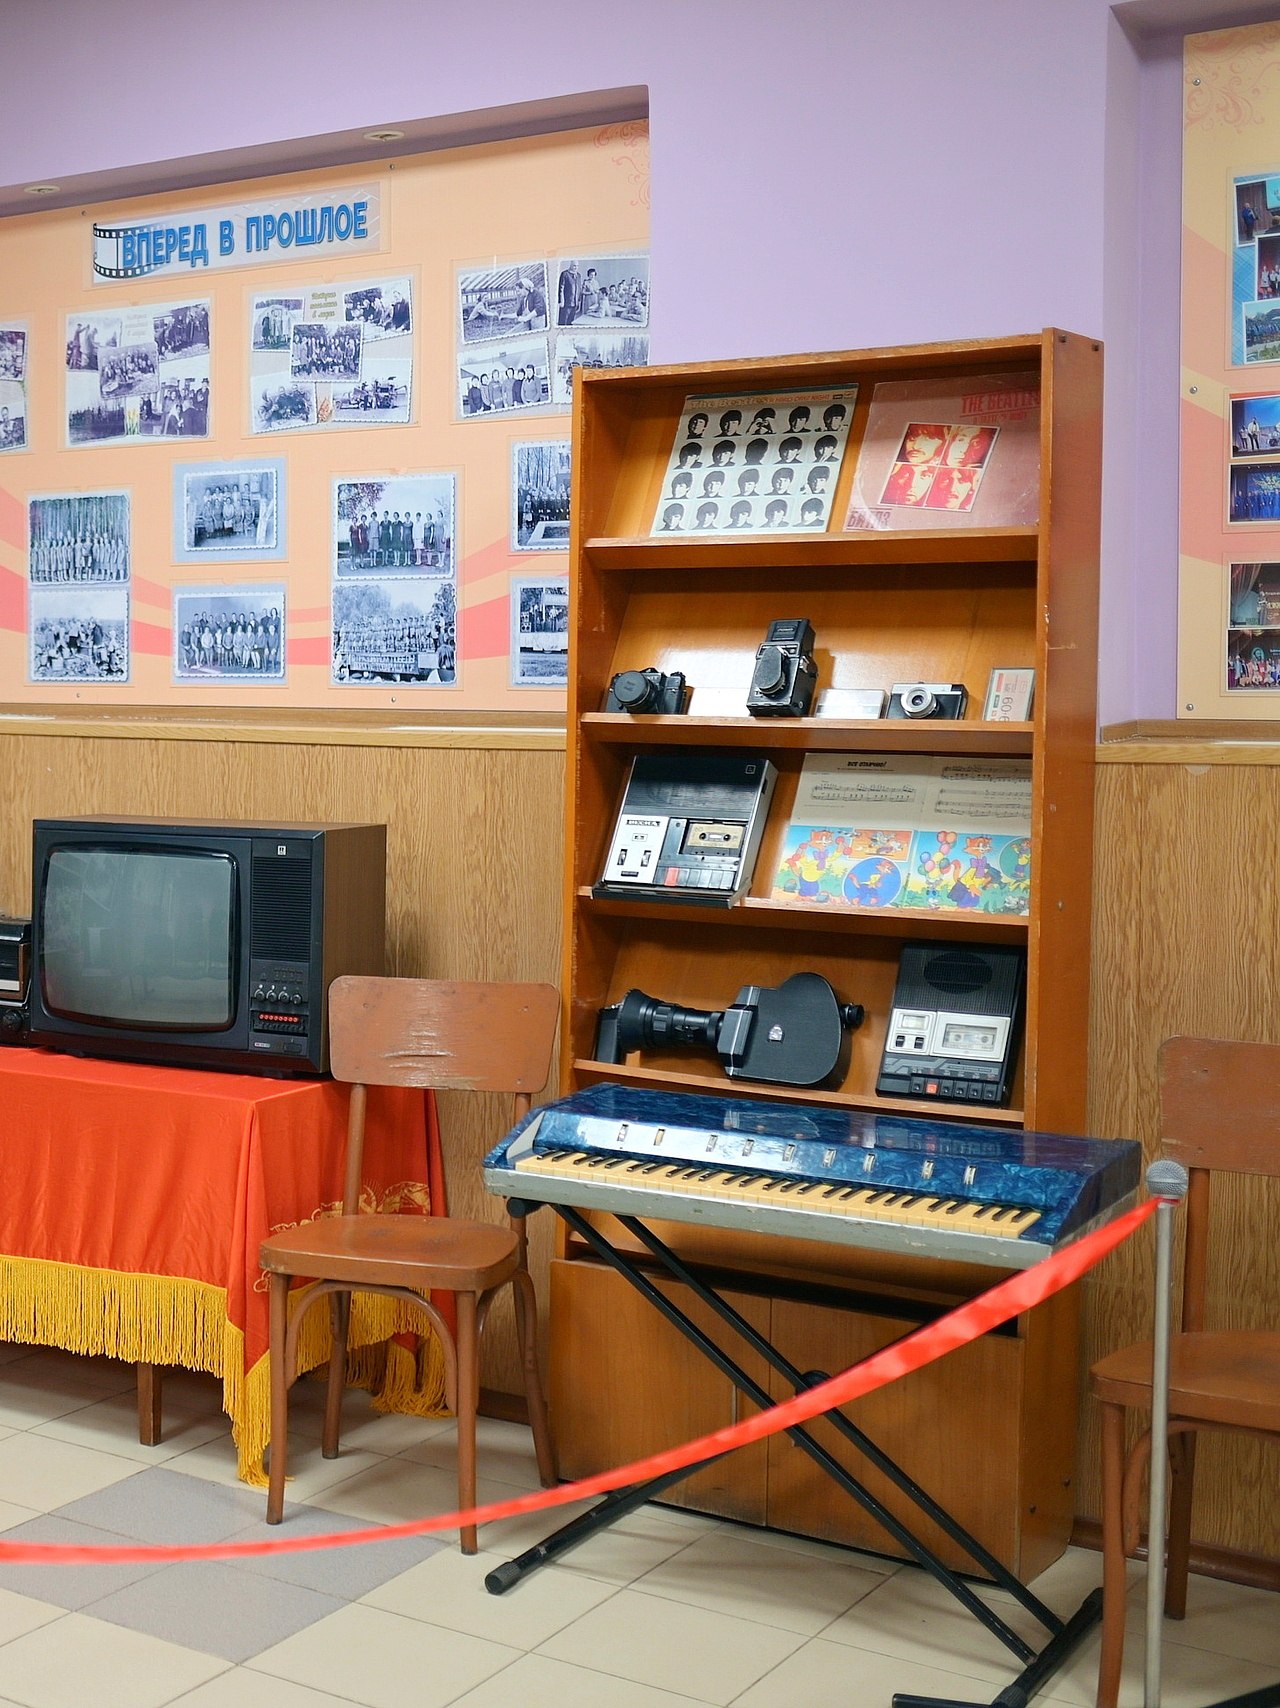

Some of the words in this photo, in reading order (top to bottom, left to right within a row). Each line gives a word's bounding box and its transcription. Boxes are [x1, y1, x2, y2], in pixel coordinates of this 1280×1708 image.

[122, 223, 209, 269] ВПЕРЕД
[219, 219, 235, 256] В
[246, 201, 368, 252] ПРОШЛОЕ
